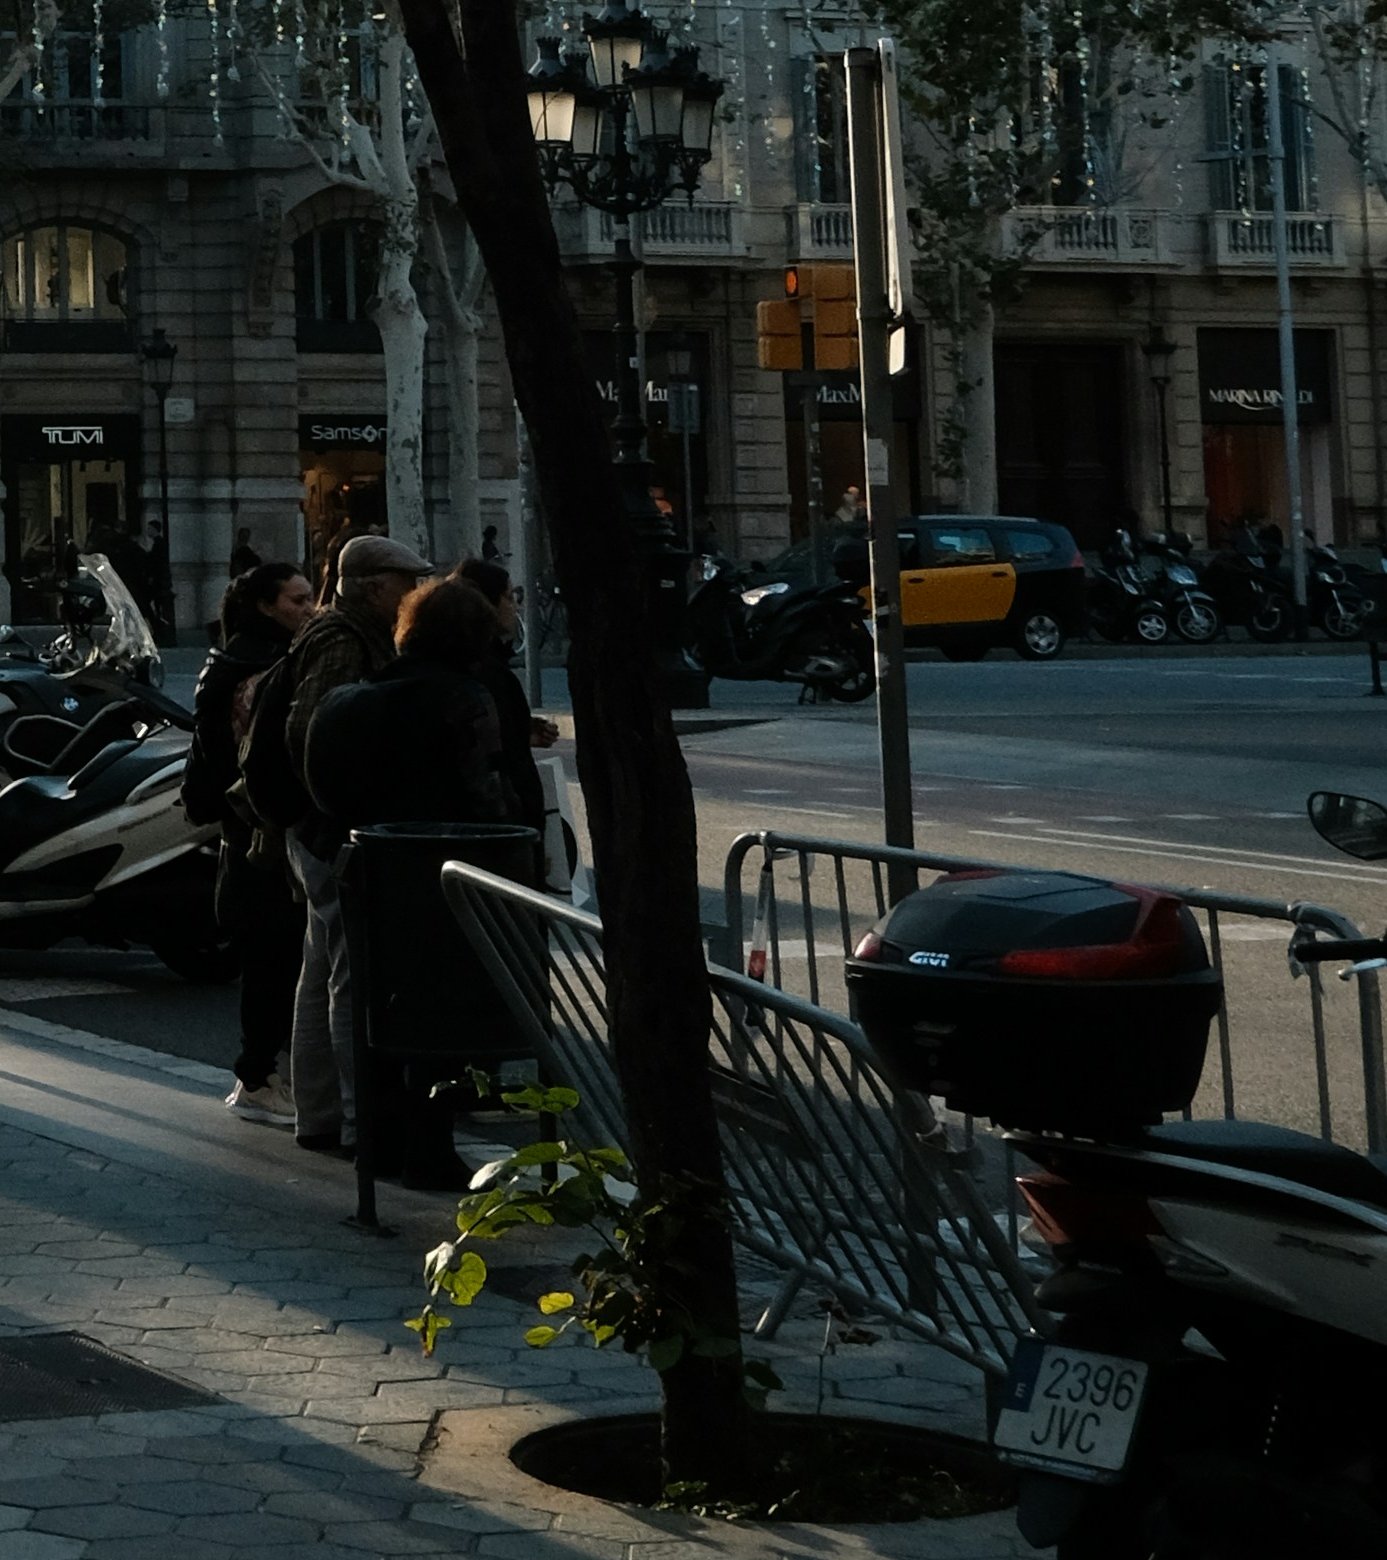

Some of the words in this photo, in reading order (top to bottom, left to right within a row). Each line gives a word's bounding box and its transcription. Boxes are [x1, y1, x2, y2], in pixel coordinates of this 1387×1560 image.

[1208, 388, 1261, 410] MARINA
[41, 426, 103, 445] TUMI
[1014, 1382, 1028, 1399] E
[1043, 1358, 1138, 1411] 2396
[1030, 1404, 1101, 1454] JVC
